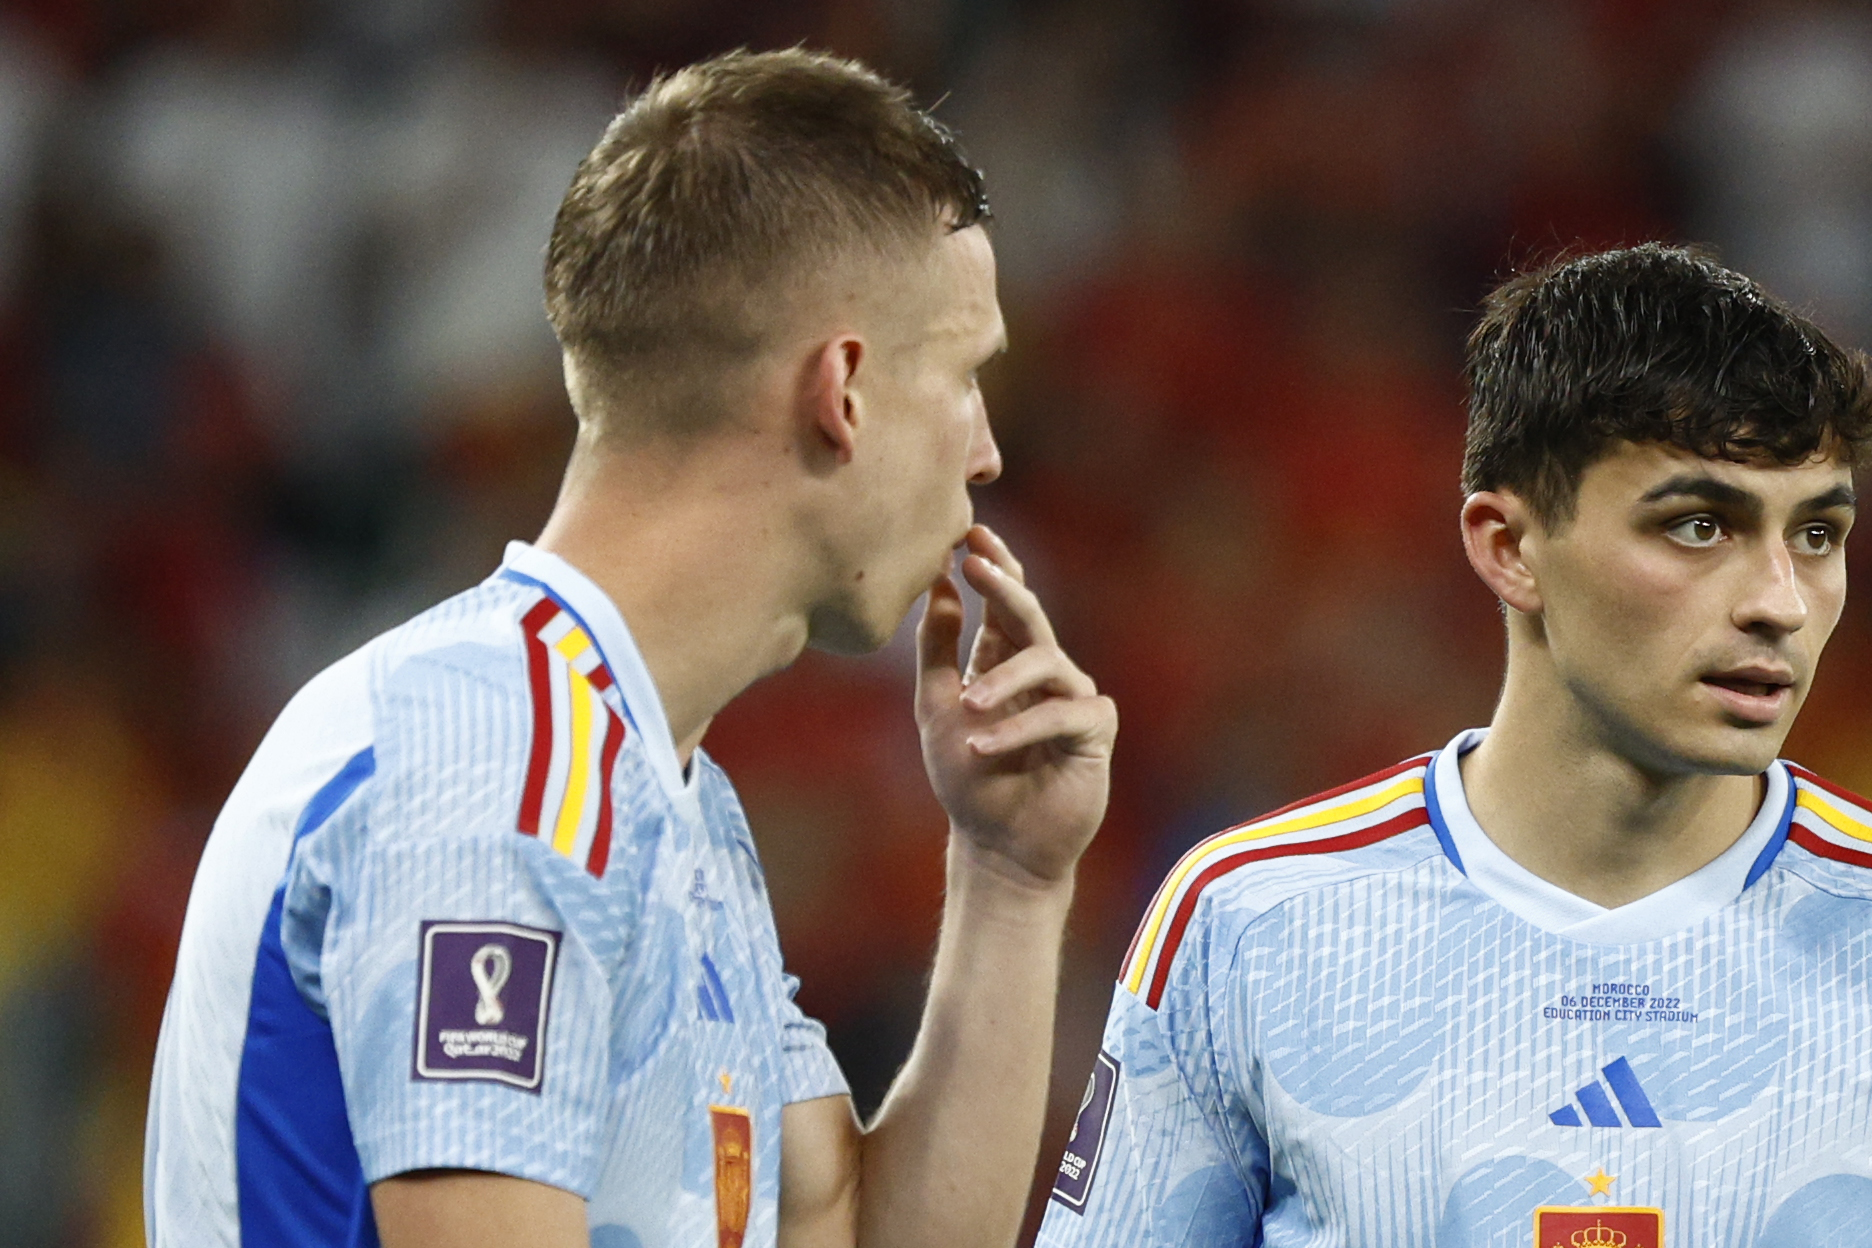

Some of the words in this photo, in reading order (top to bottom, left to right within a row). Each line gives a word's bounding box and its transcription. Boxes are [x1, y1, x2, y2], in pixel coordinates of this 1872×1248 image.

[1592, 983, 1650, 996] MOROCCO
[1561, 995, 1577, 1008] 06
[1581, 996, 1646, 1009] DECEMBER
[1649, 997, 1681, 1010] 2022
[1543, 1007, 1611, 1022] EDUCATION
[1614, 1009, 1642, 1022] CITY
[1645, 1010, 1699, 1024] STADIUM
[1059, 1160, 1081, 1181] 2022
